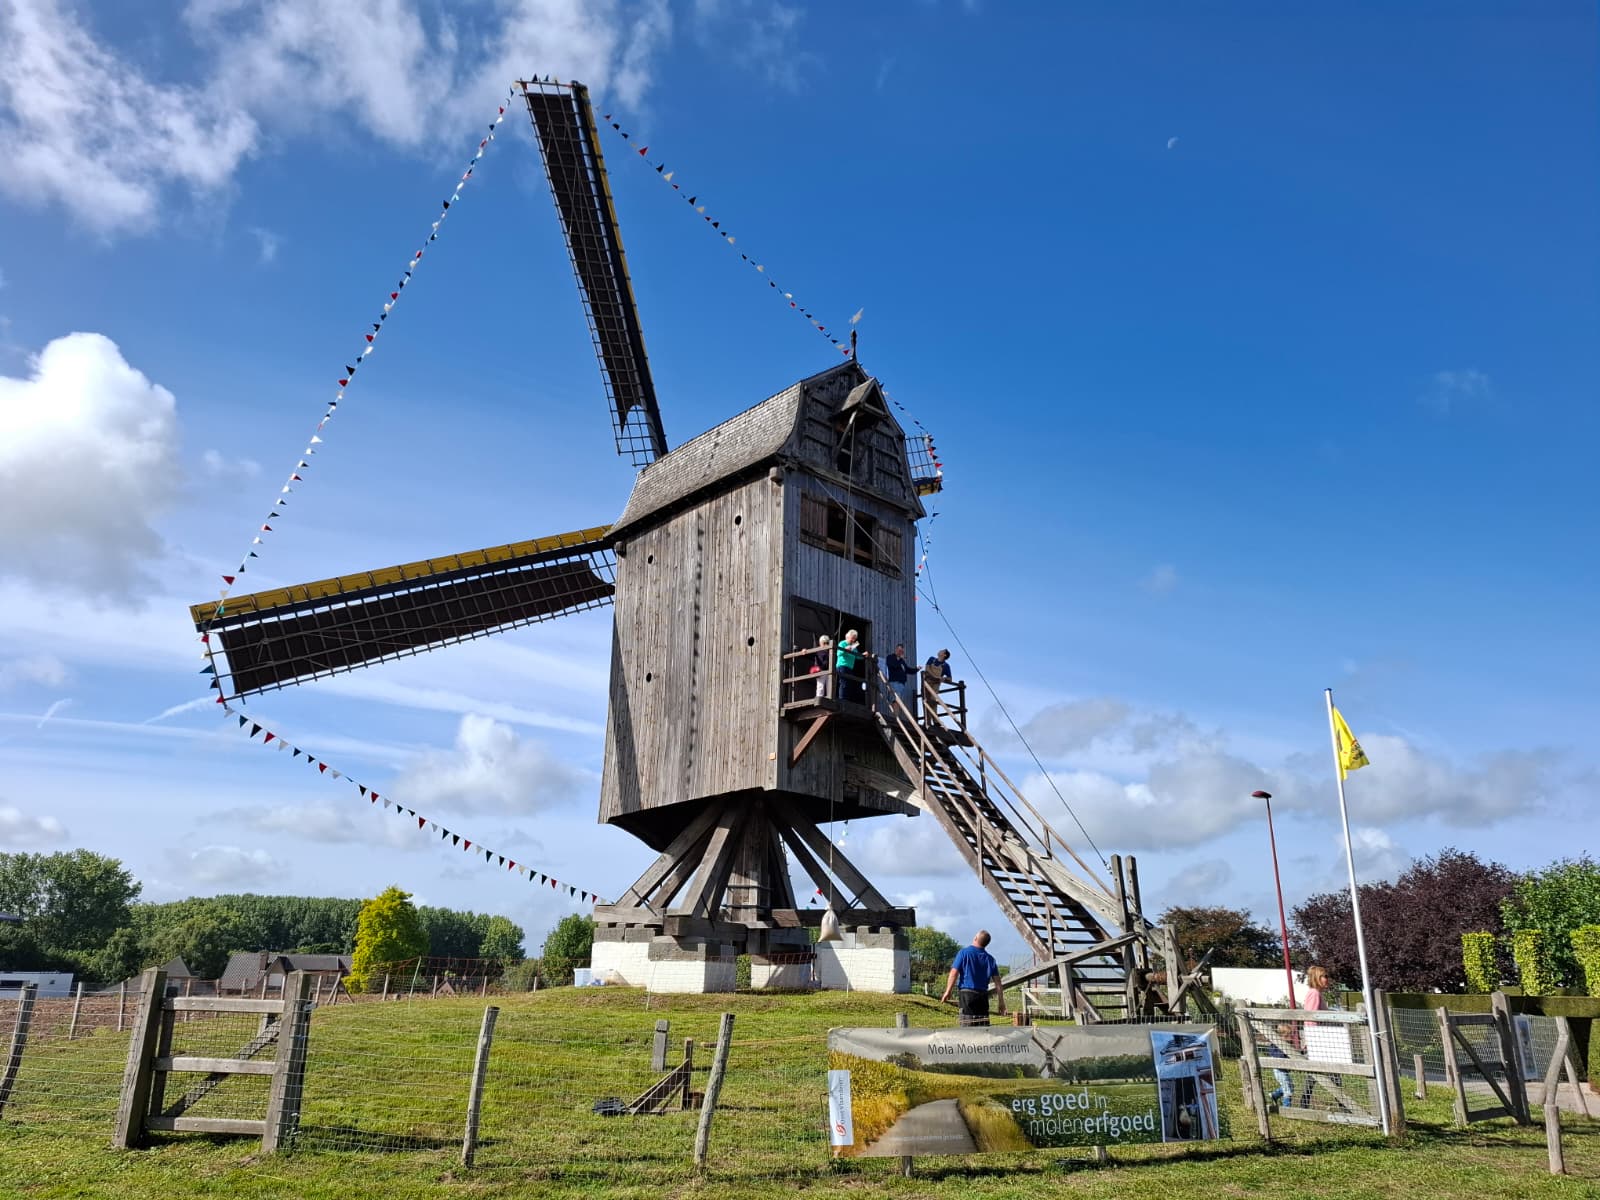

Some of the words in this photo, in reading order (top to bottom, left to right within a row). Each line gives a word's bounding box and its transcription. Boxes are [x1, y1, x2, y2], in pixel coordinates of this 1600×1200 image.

[928, 1043, 954, 1055] Mola
[957, 1043, 1030, 1054] Molencentrum
[1012, 1098, 1036, 1116] erg
[1041, 1087, 1089, 1116] goed
[1095, 1092, 1107, 1109] in
[1030, 1109, 1154, 1137] molenerfgoed
